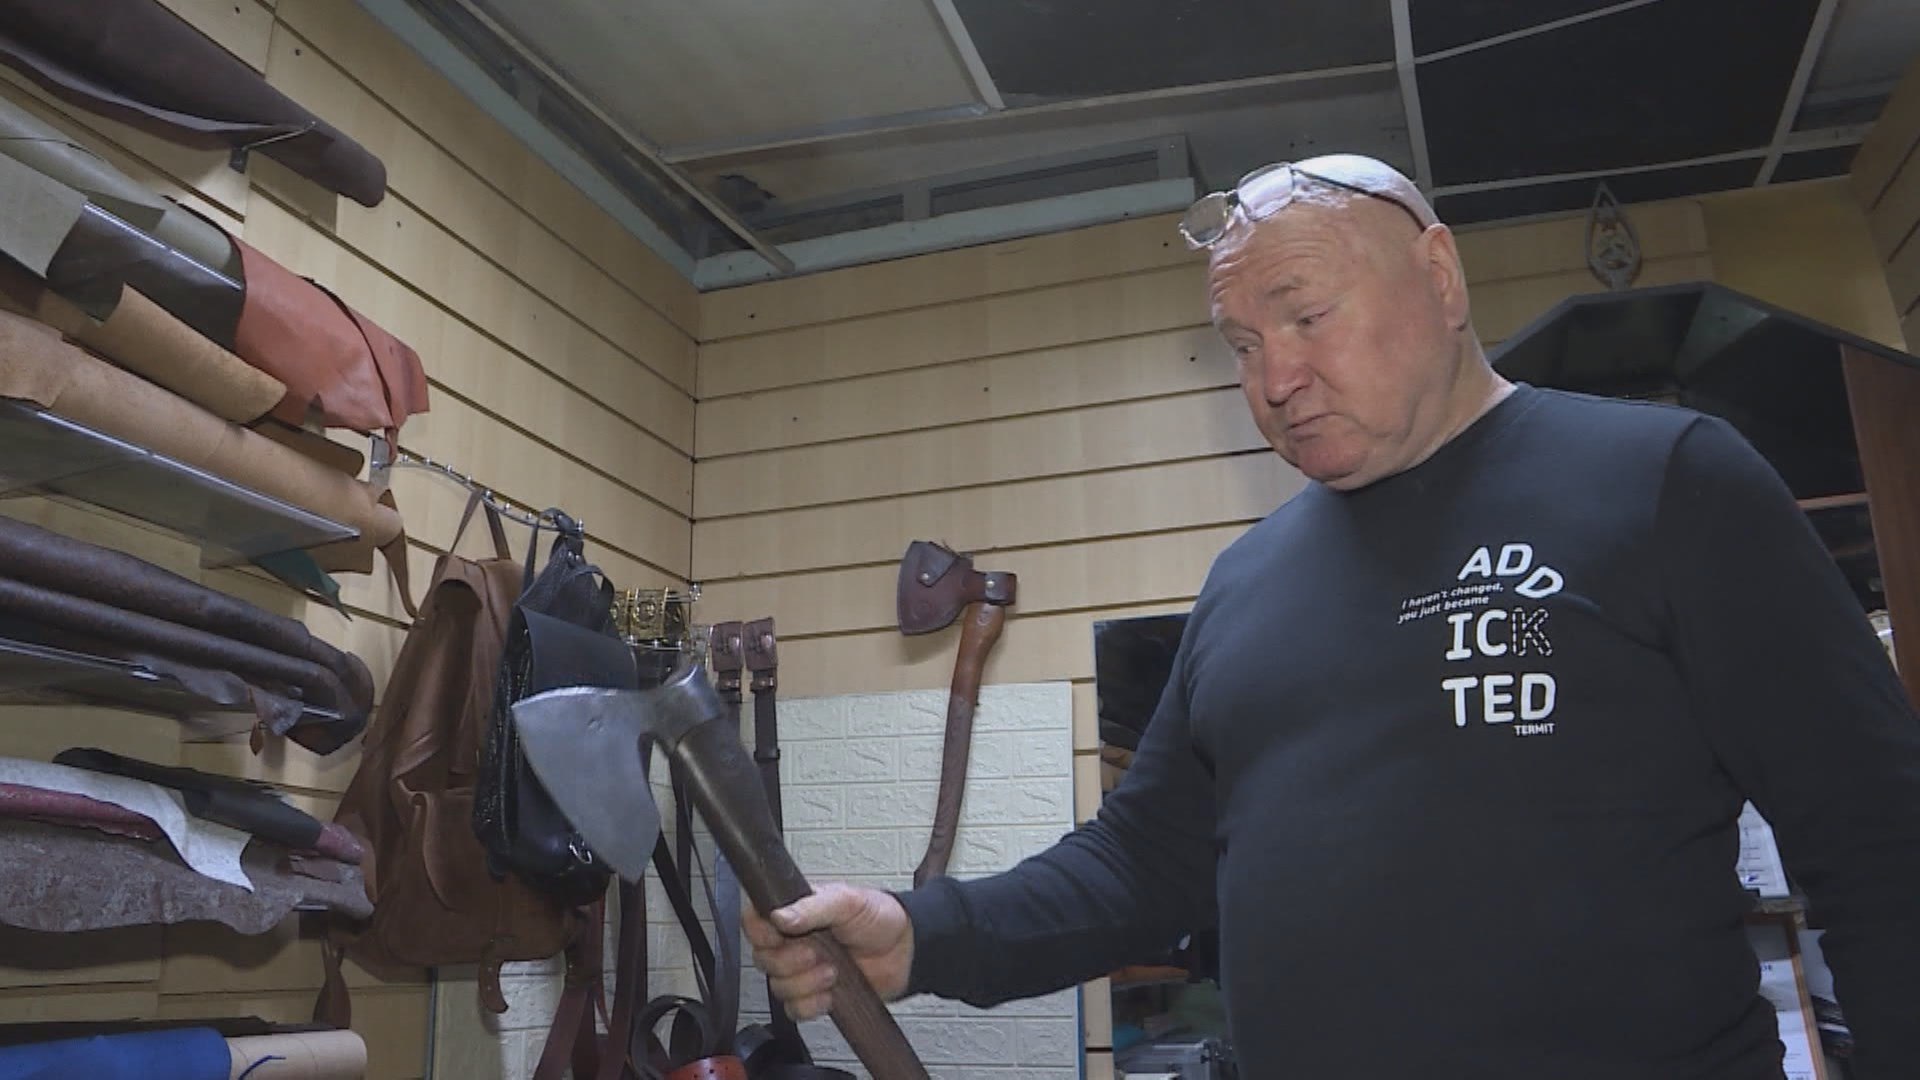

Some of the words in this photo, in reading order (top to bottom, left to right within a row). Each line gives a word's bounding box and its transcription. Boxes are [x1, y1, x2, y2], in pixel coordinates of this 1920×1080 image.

[1457, 543, 1564, 599] ADD
[1397, 610, 1418, 624] you
[1419, 603, 1441, 618] just
[1444, 596, 1489, 610] became
[1409, 591, 1448, 608] haven't
[1450, 582, 1504, 596] changed,
[1445, 607, 1553, 660] ICK
[1441, 672, 1556, 727] TED
[1513, 723, 1555, 737] TERMIT
